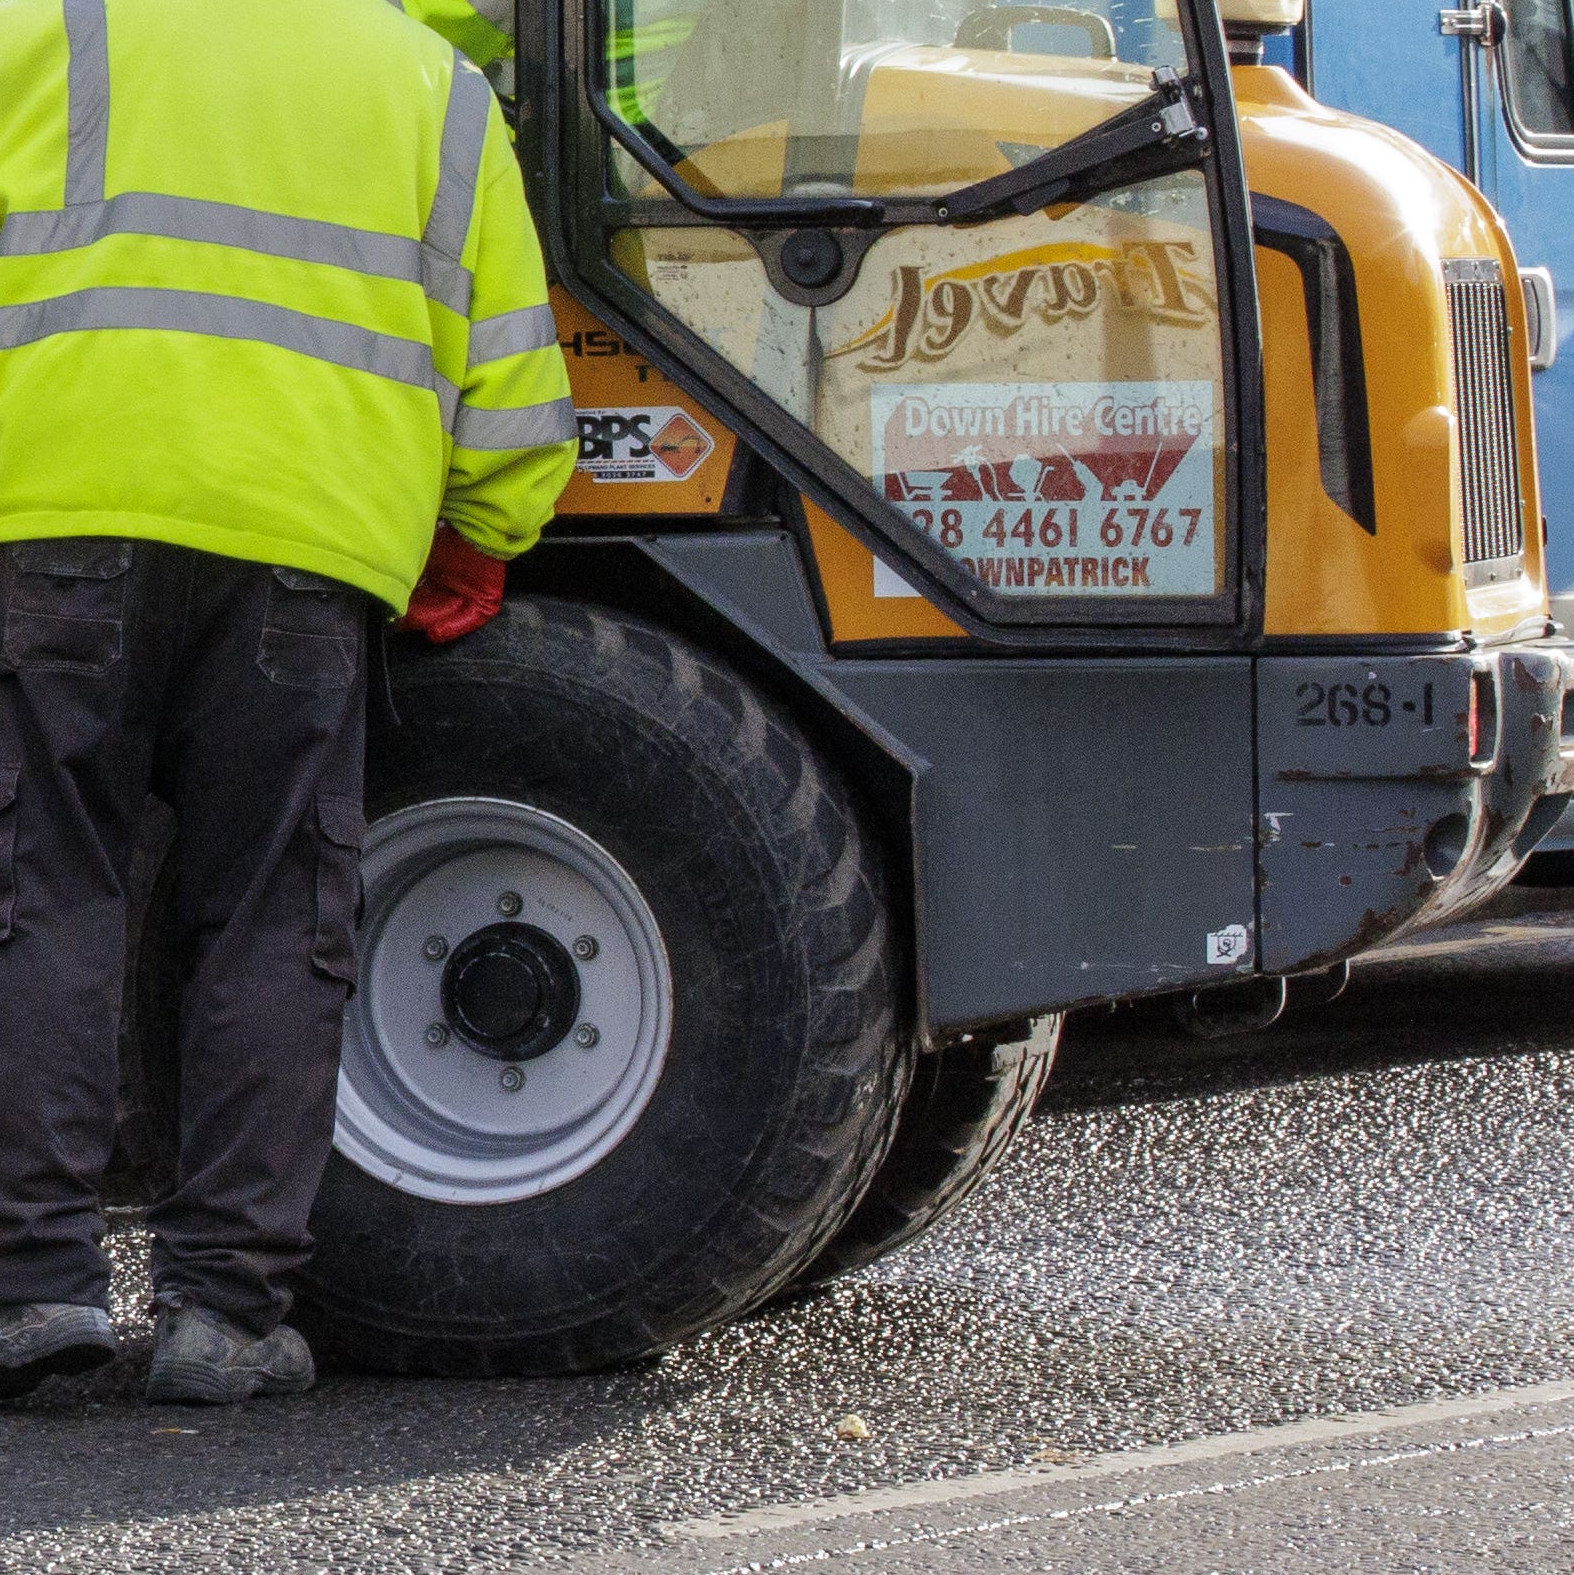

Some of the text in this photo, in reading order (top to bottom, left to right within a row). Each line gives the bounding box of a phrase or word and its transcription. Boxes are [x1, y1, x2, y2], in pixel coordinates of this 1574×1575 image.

[576, 414, 652, 460] BPS
[902, 395, 1201, 437] Down Hire Centre
[911, 507, 1202, 549] 28 4461 6767
[961, 556, 1152, 588] OWNPATRICK
